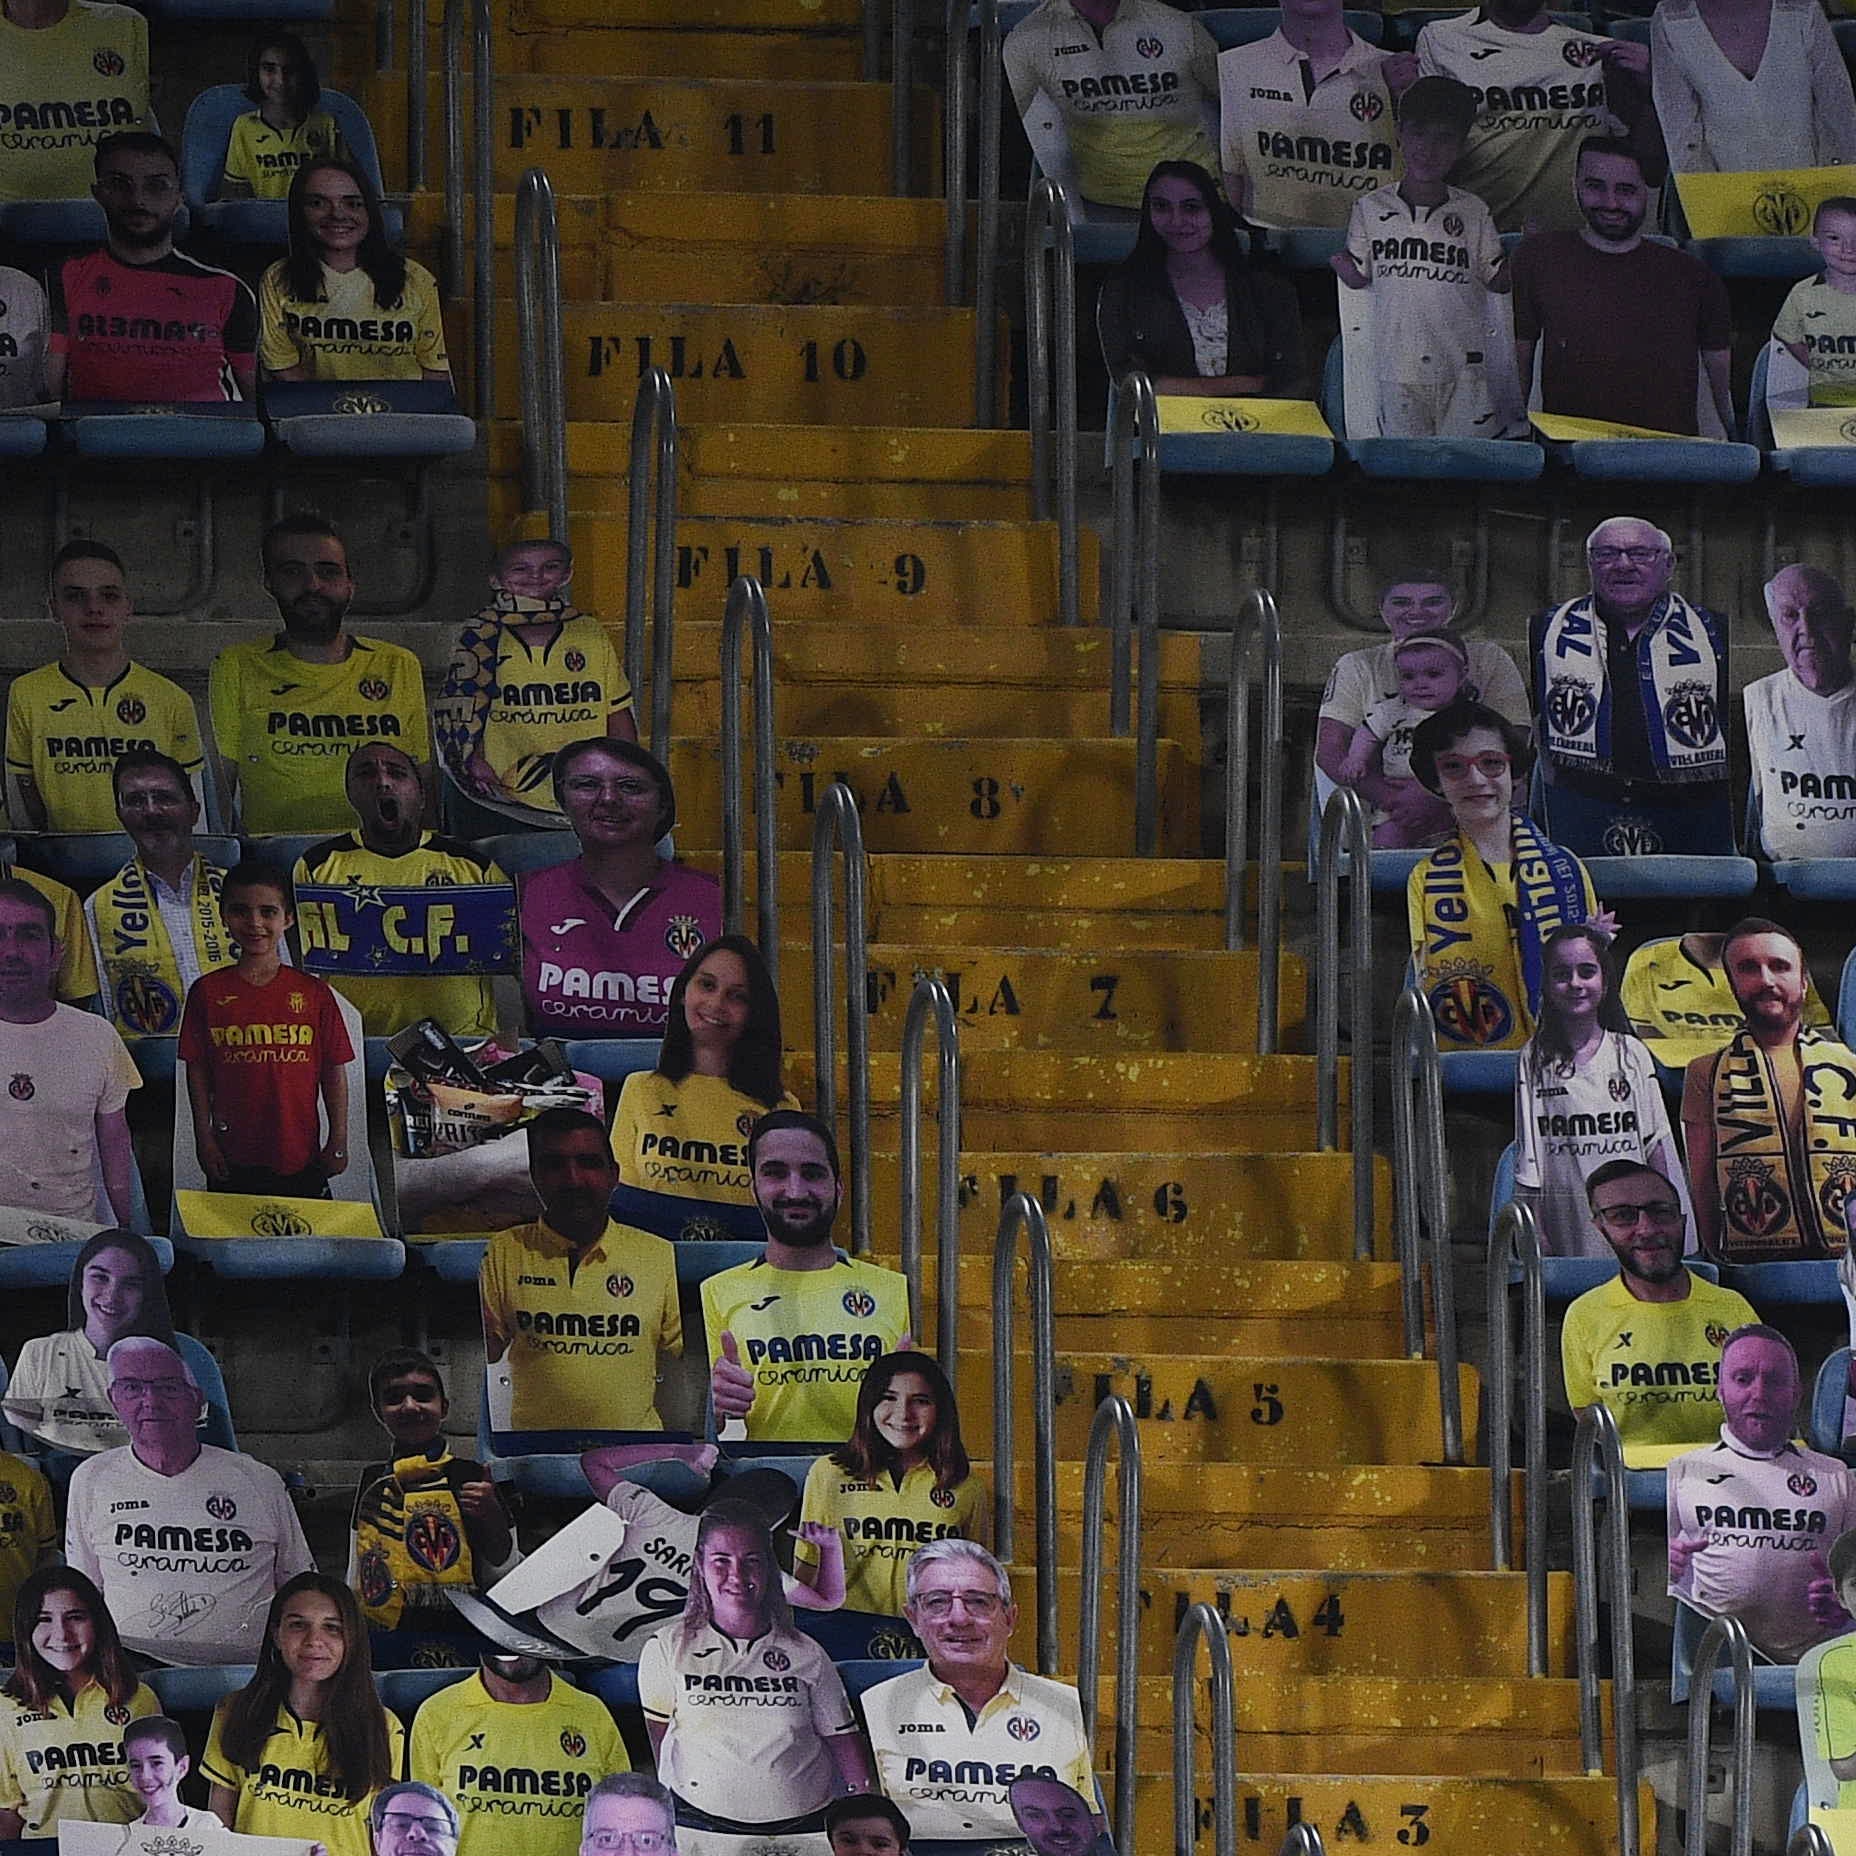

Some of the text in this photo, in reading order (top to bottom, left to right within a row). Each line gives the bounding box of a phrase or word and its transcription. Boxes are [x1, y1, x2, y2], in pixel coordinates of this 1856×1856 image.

[1062, 73, 1178, 97] PAMESA
[1472, 83, 1603, 110] PAMESA
[510, 107, 777, 155] FILA 11
[1257, 131, 1393, 170] PAMESA
[1372, 238, 1470, 268] PAMESA
[284, 311, 414, 341] PAMESA
[588, 335, 867, 383] FILA 10
[677, 545, 926, 596] FILA 9
[267, 711, 400, 737] PAMESA
[970, 776, 1002, 820] 8
[1089, 974, 1119, 1020] 7
[210, 1024, 312, 1048] PAMESA
[1537, 1113, 1637, 1137] PAMESA
[1153, 1181, 1188, 1225] 6
[517, 1314, 640, 1338] PAMESA
[748, 1334, 882, 1362] PAMESA
[1250, 1383, 1284, 1427] 5
[1695, 1505, 1826, 1534] PAMESA
[114, 1524, 253, 1552] PAMESA
[1312, 1592, 1345, 1637] 4
[685, 1674, 798, 1694] PAMESA
[458, 1764, 592, 1793] PAMESA
[1396, 1804, 1430, 1847] 3
